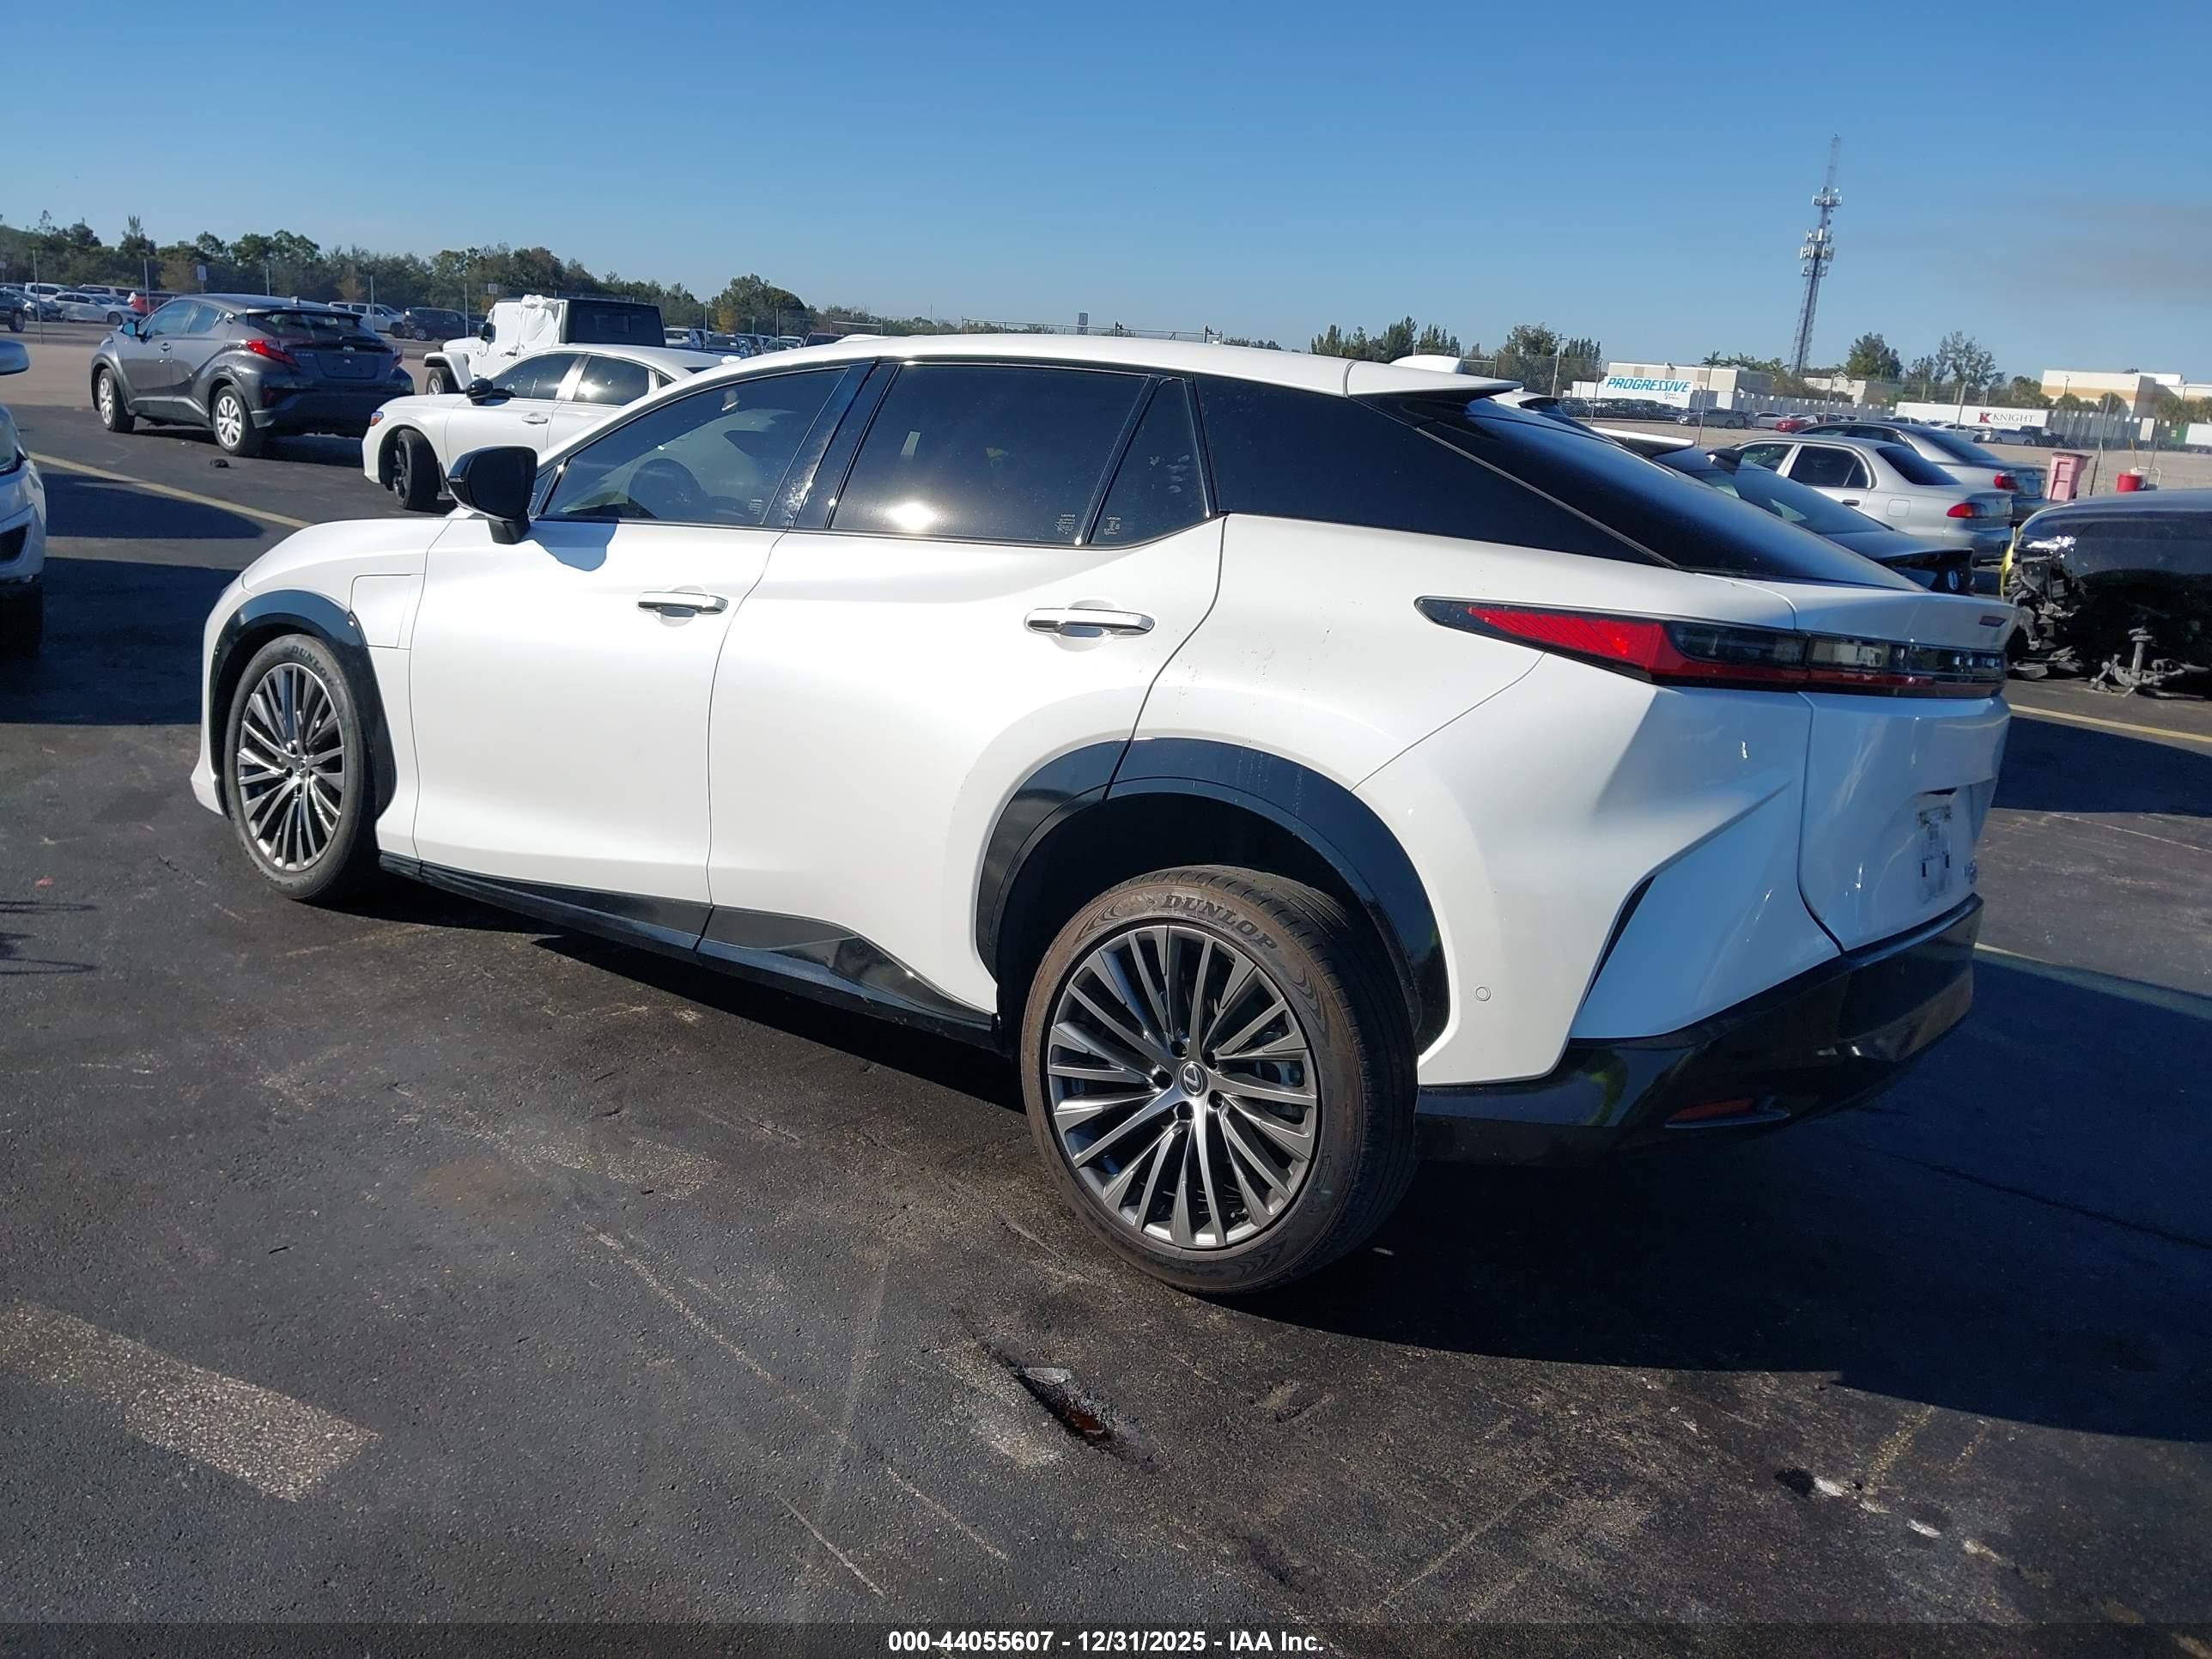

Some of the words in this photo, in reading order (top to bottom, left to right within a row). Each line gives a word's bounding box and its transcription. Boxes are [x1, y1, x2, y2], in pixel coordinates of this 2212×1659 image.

[1607, 377, 1692, 392] PROGRESSIVE
[1992, 412, 2034, 422] KNIGHT
[1161, 895, 1279, 950] DUNLOP
